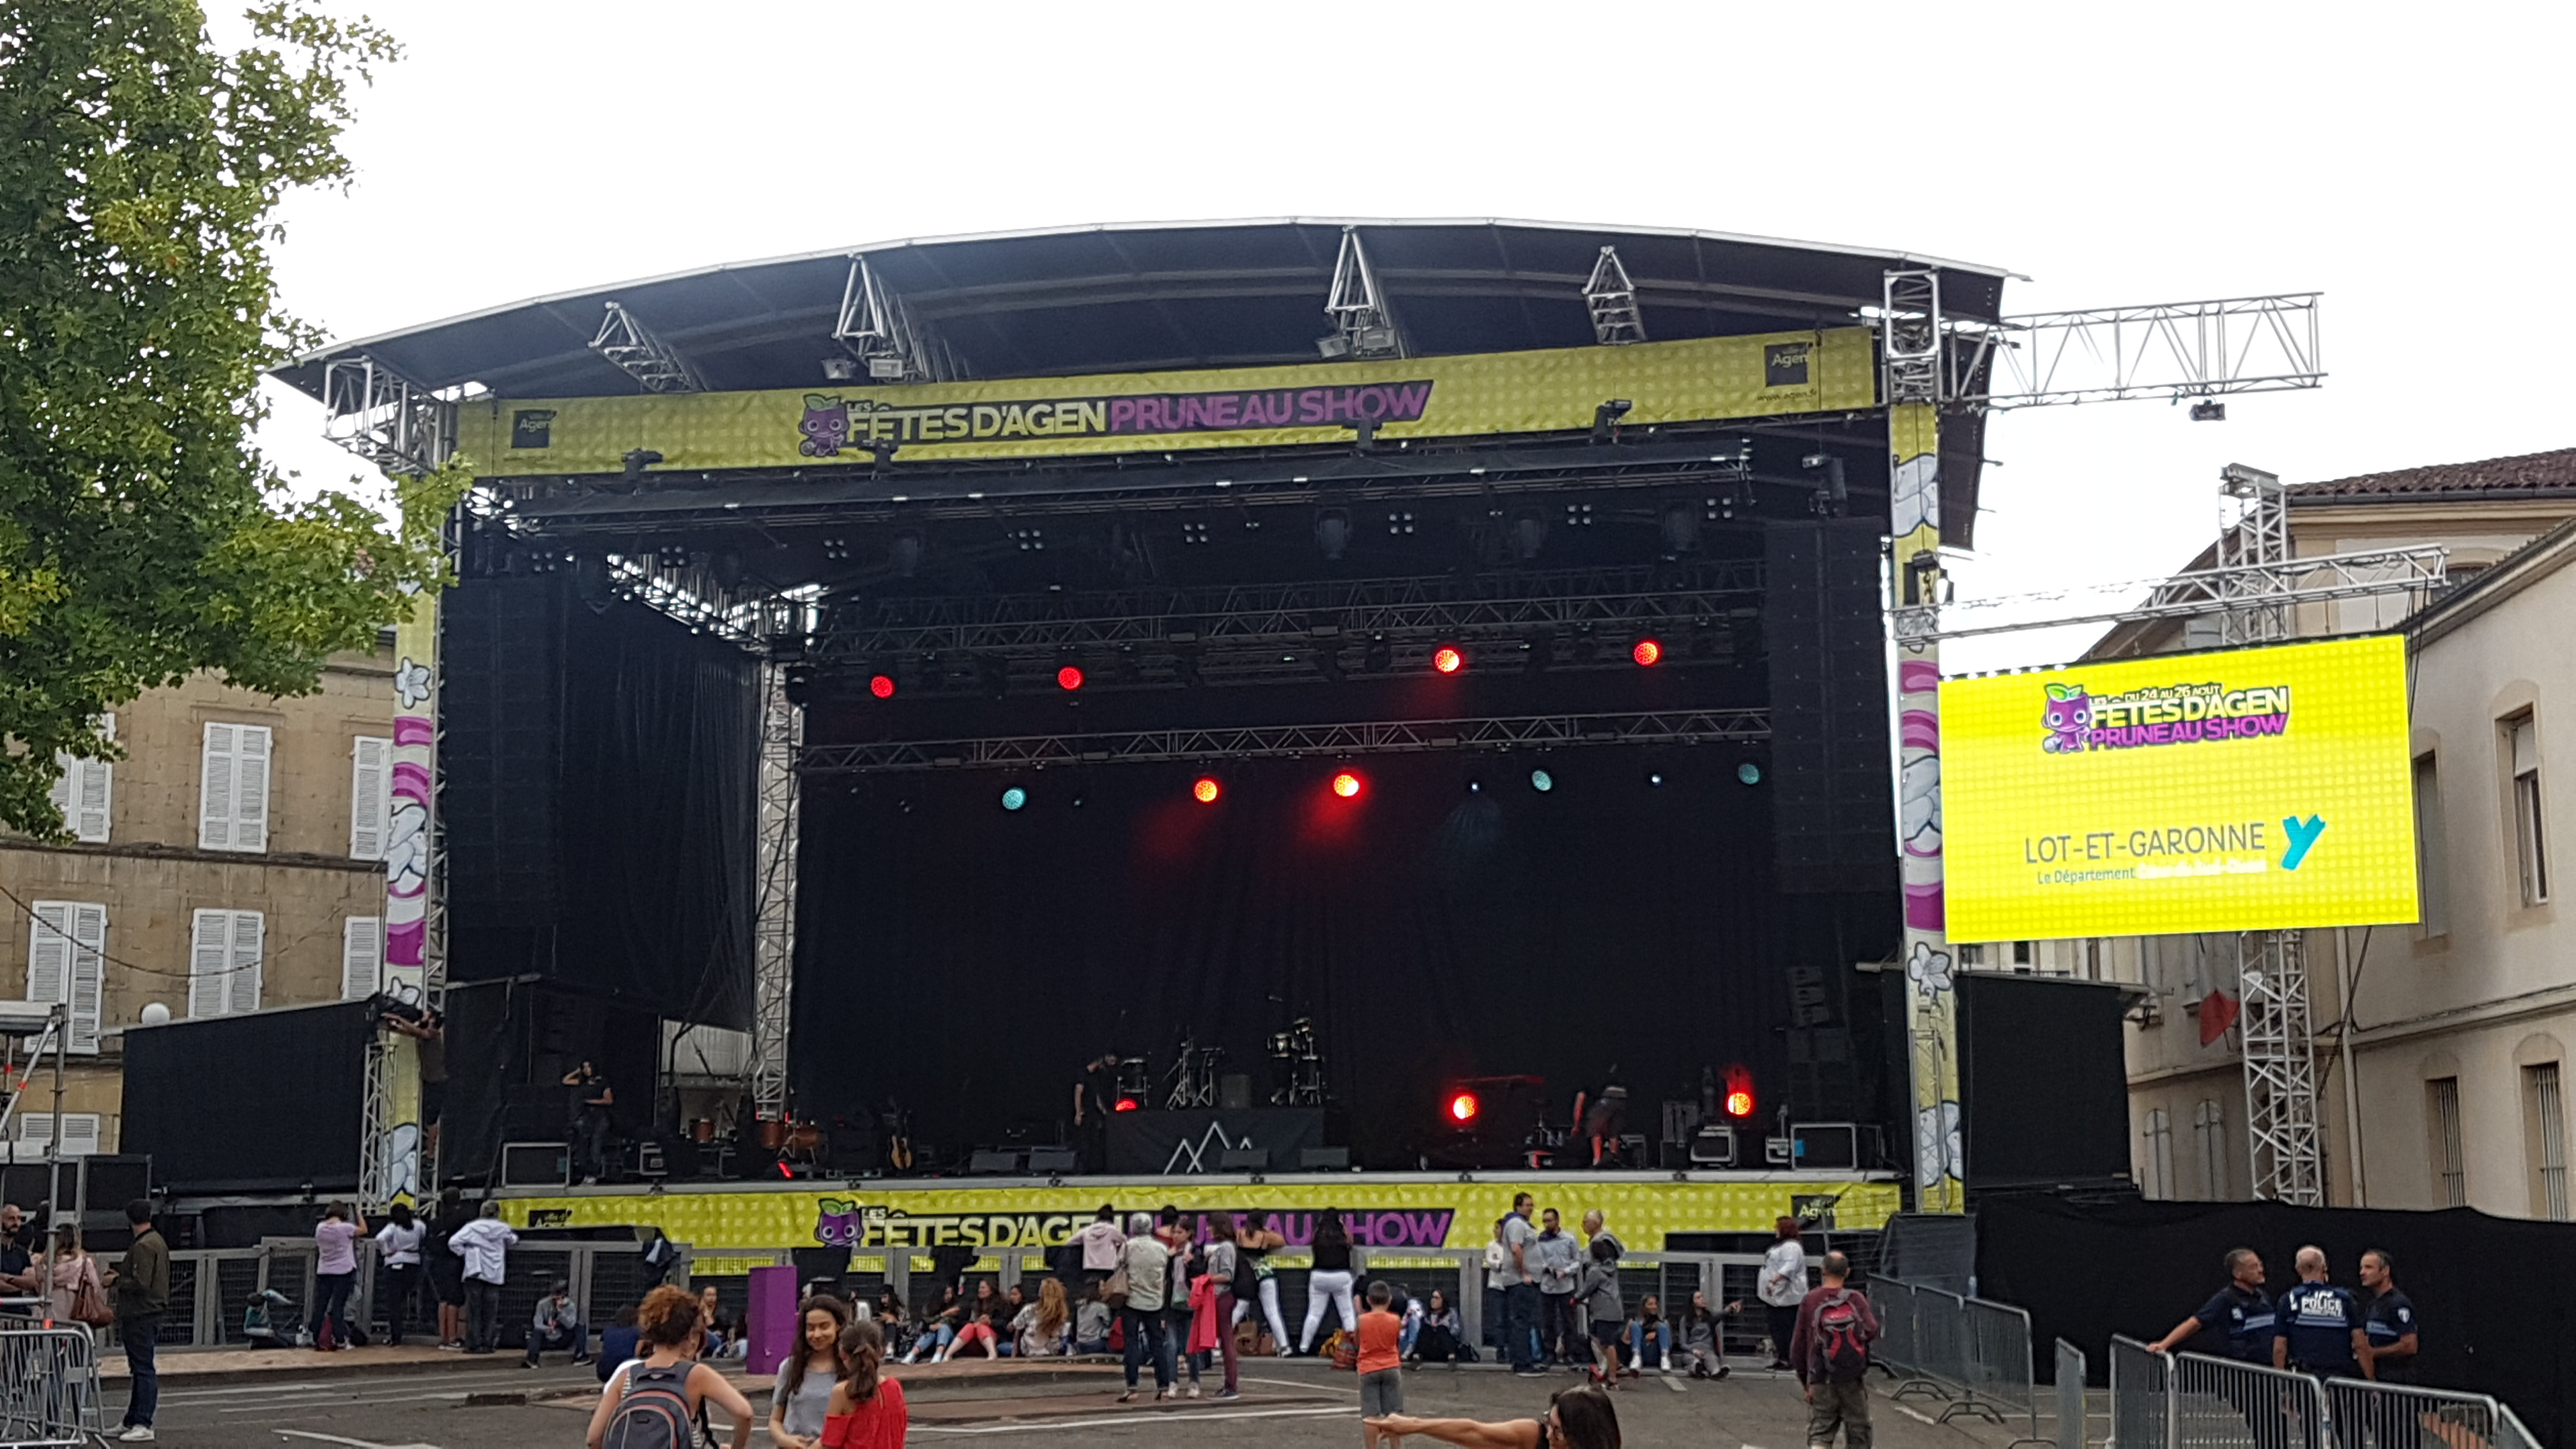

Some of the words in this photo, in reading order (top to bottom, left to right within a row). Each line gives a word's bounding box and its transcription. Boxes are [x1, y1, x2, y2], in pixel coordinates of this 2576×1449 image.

[1772, 353, 1809, 368] Agen
[847, 402, 871, 412] LES
[972, 401, 1107, 438] D'AGEN
[1111, 392, 1293, 432] PRUNEAU
[1298, 385, 1429, 423] SHOW
[2140, 689, 2158, 701] 24
[2159, 689, 2173, 699] AU
[2174, 686, 2191, 698] 26
[2183, 687, 2287, 721] D'AGEN
[2091, 721, 2202, 748] PRUNEAU
[2205, 713, 2286, 739] SHOW
[2025, 822, 2266, 864] LOT-ET-GARONNE
[2037, 871, 2051, 884] Le
[2054, 867, 2136, 885] Département
[863, 1208, 887, 1219] LES
[1798, 1204, 1838, 1220] Agn
[1344, 1212, 1451, 1246] HOW
